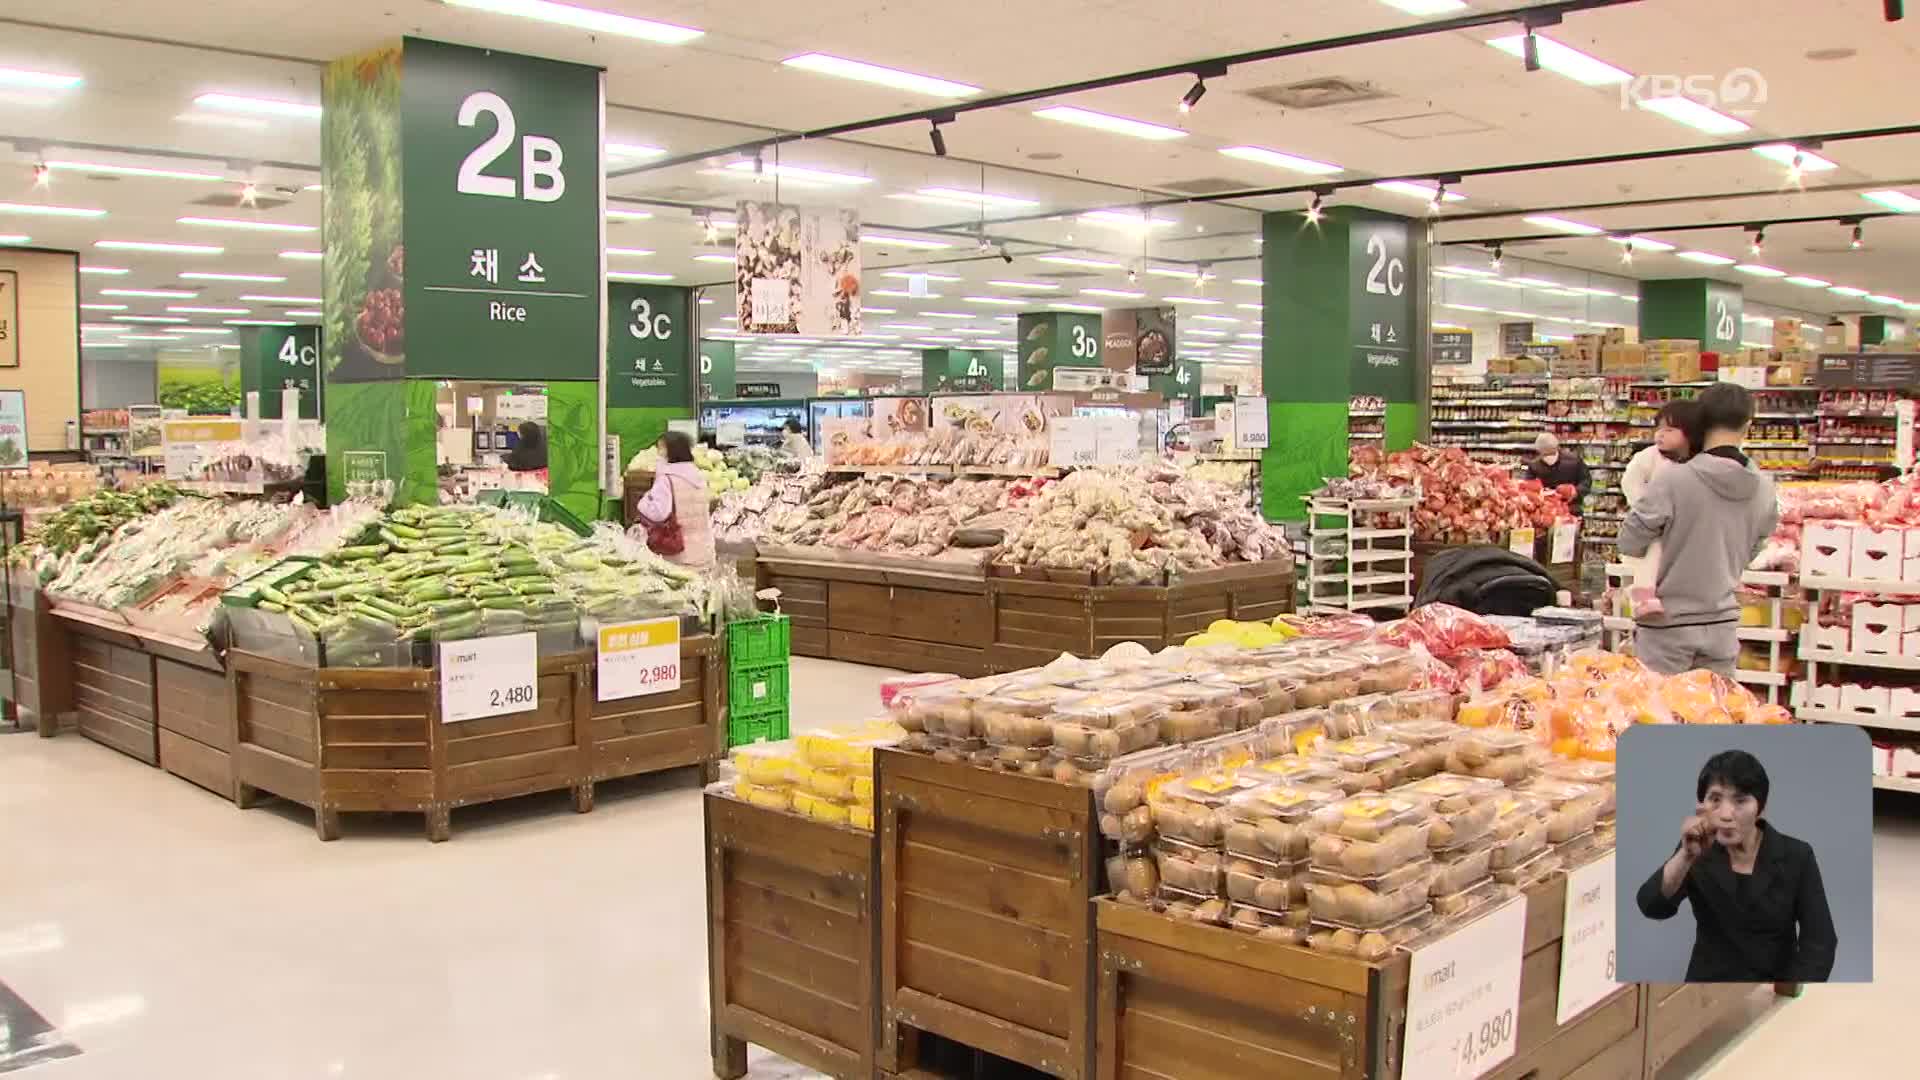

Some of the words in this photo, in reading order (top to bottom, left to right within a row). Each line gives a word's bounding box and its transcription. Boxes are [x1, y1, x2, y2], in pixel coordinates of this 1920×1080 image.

[457, 91, 566, 202] 2B
[1366, 233, 1404, 296] 2C
[490, 302, 527, 321] Rice
[629, 298, 672, 340] 3C
[279, 335, 315, 366] 4C
[1072, 325, 1098, 358] 3D
[640, 664, 677, 687] 2,980
[490, 685, 533, 707] 2,480
